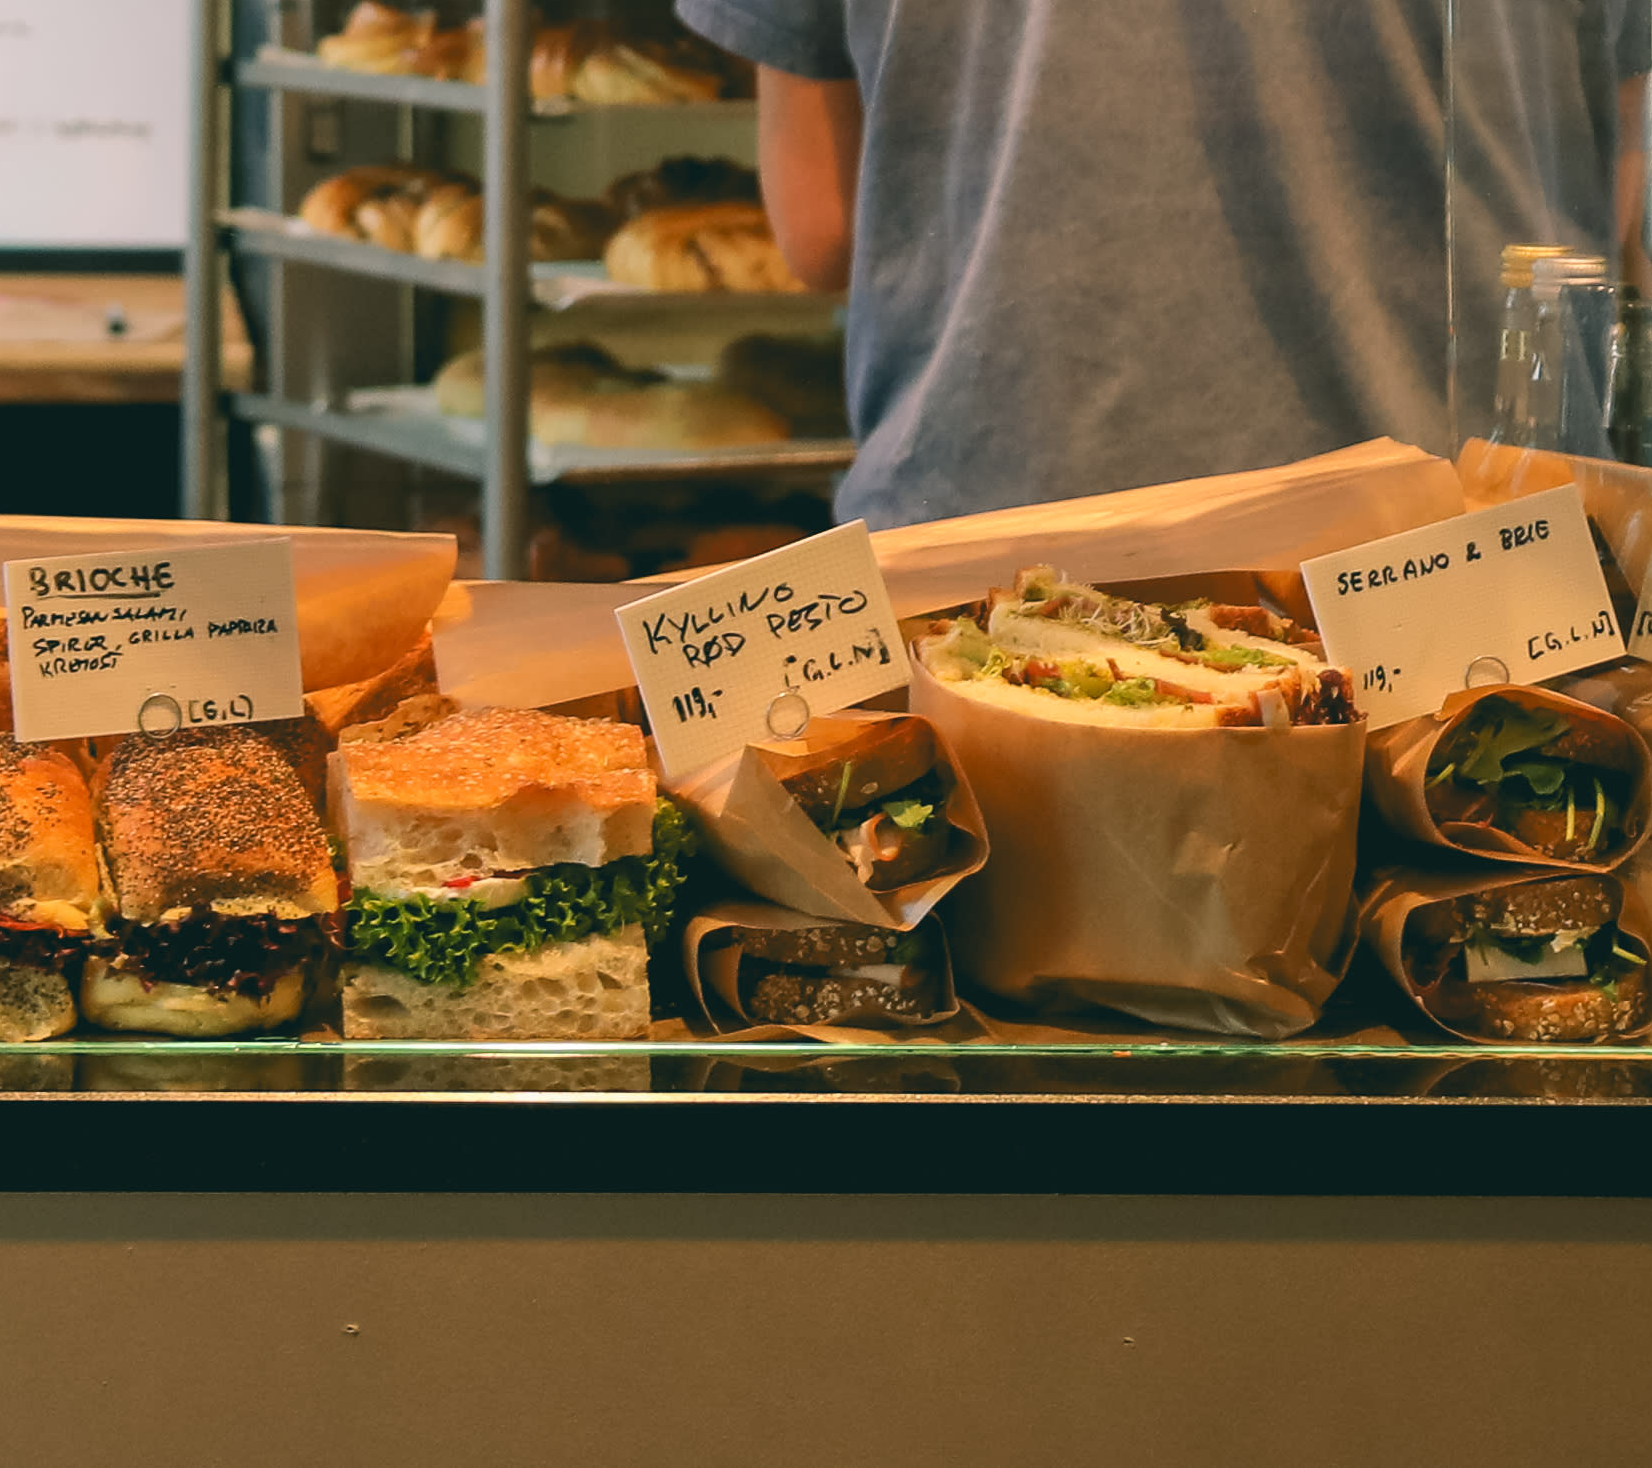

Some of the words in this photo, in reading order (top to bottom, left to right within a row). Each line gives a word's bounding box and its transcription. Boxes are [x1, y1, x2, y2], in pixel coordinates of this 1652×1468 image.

[1337, 553, 1450, 596] SERRANO
[1499, 519, 1550, 551] BRIE
[29, 562, 175, 597] BRIOCHE
[766, 590, 868, 639] PESTO
[129, 628, 194, 646] GRILLA
